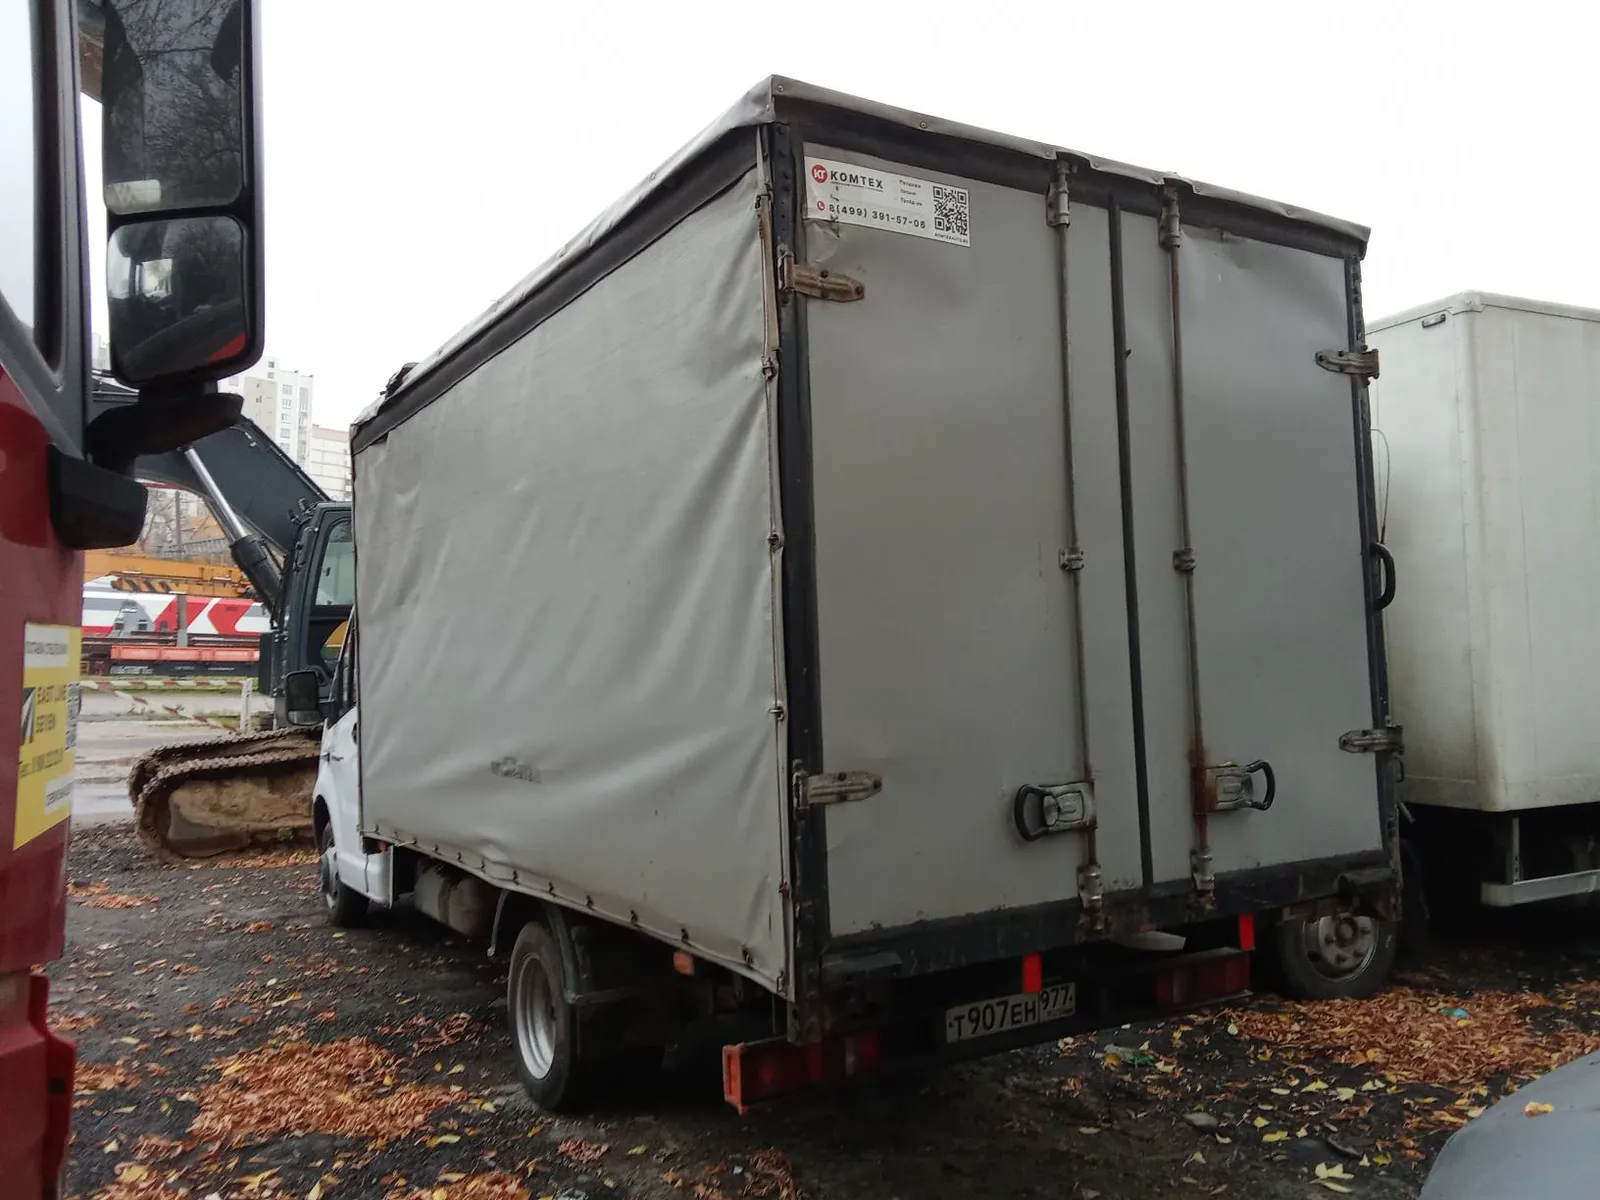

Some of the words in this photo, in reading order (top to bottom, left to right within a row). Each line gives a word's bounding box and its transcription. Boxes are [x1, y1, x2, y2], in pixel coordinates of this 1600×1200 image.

[830, 170, 884, 189] KOMTEX
[953, 1000, 1037, 1037] T907EH
[1040, 985, 1070, 1010] 977
